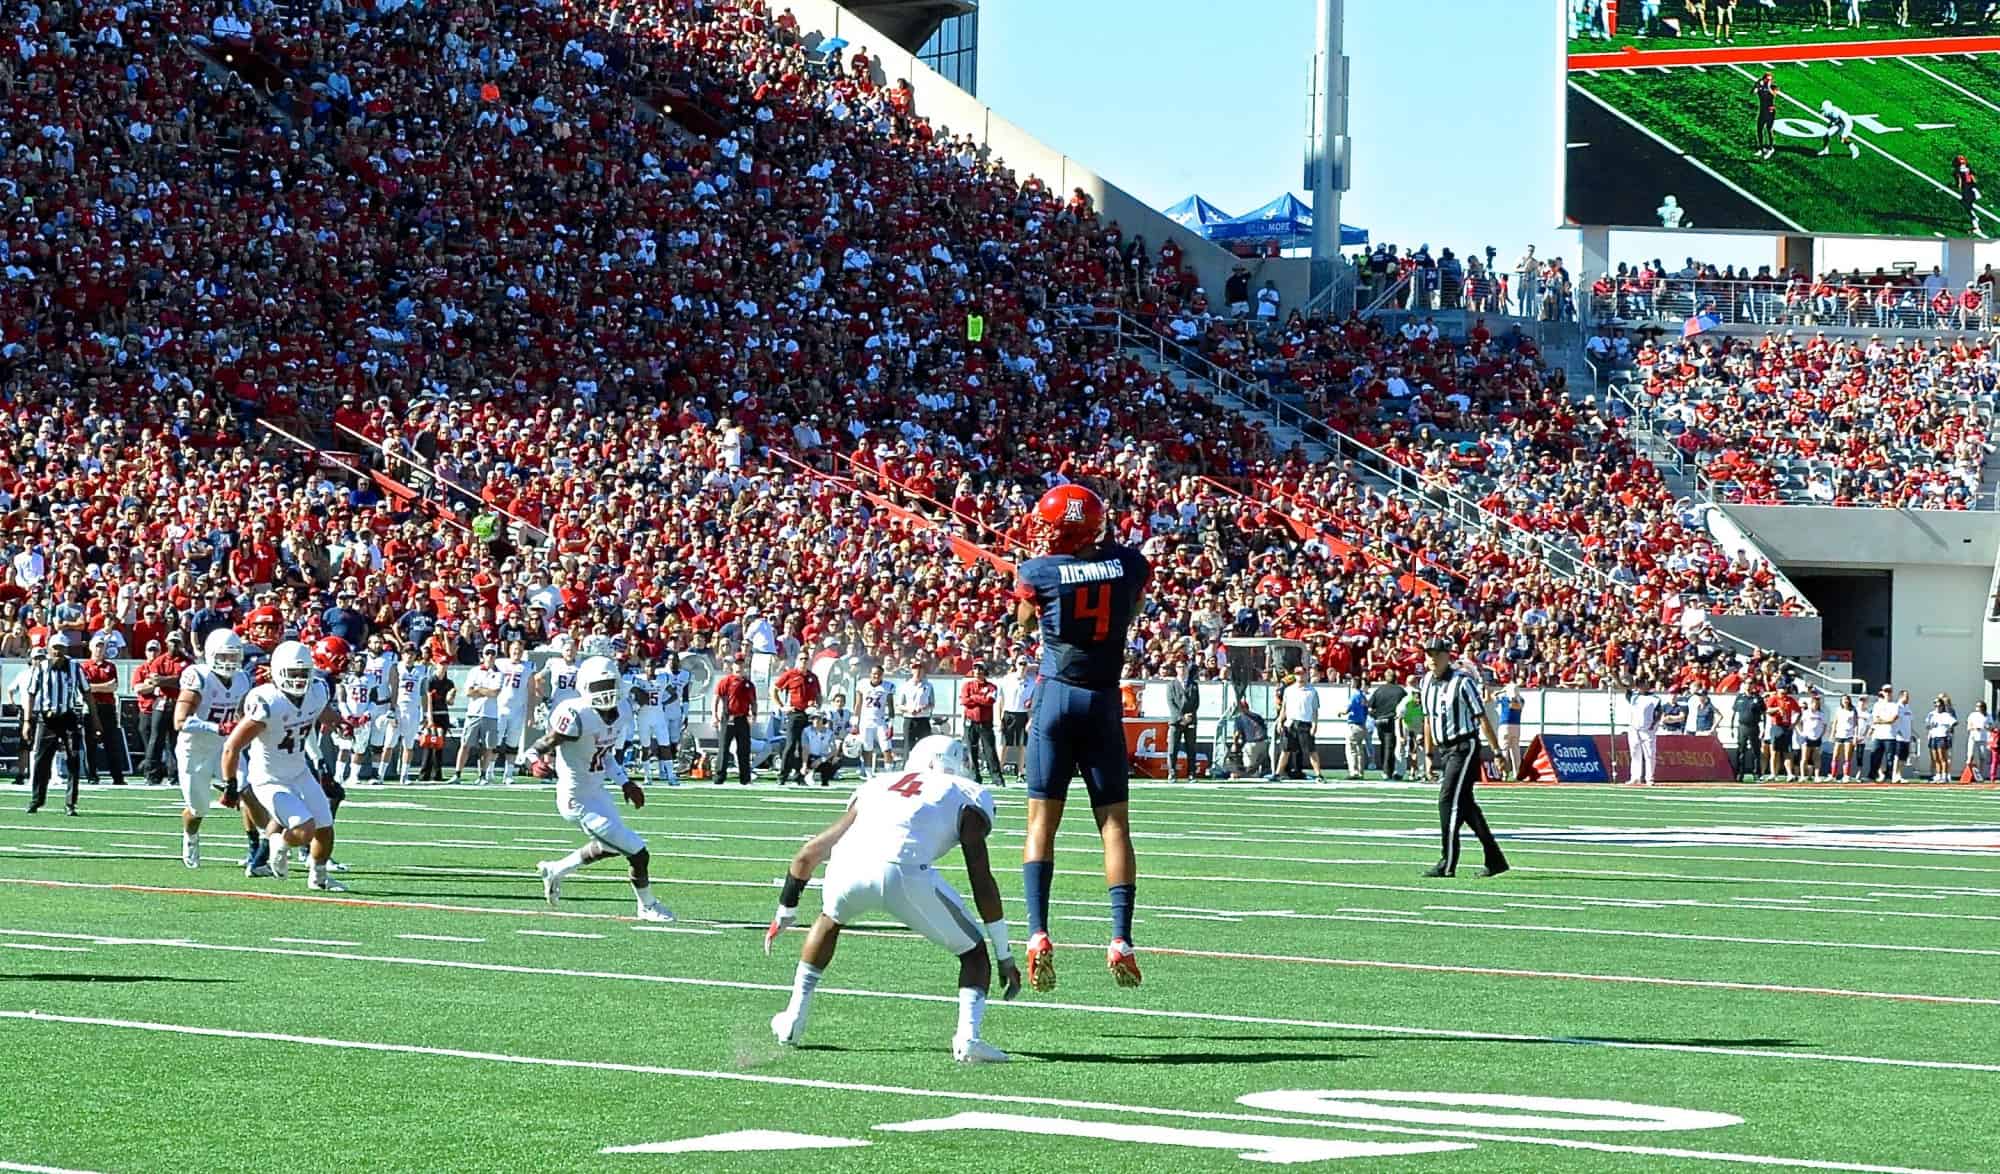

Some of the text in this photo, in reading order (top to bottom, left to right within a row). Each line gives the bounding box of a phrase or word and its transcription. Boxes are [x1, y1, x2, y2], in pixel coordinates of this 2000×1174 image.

[1074, 584, 1111, 641] 4
[559, 674, 577, 690] 64
[278, 723, 313, 754] 47
[1553, 743, 1588, 758] Game
[1553, 758, 1600, 776] Sponsor
[888, 772, 924, 798] 4
